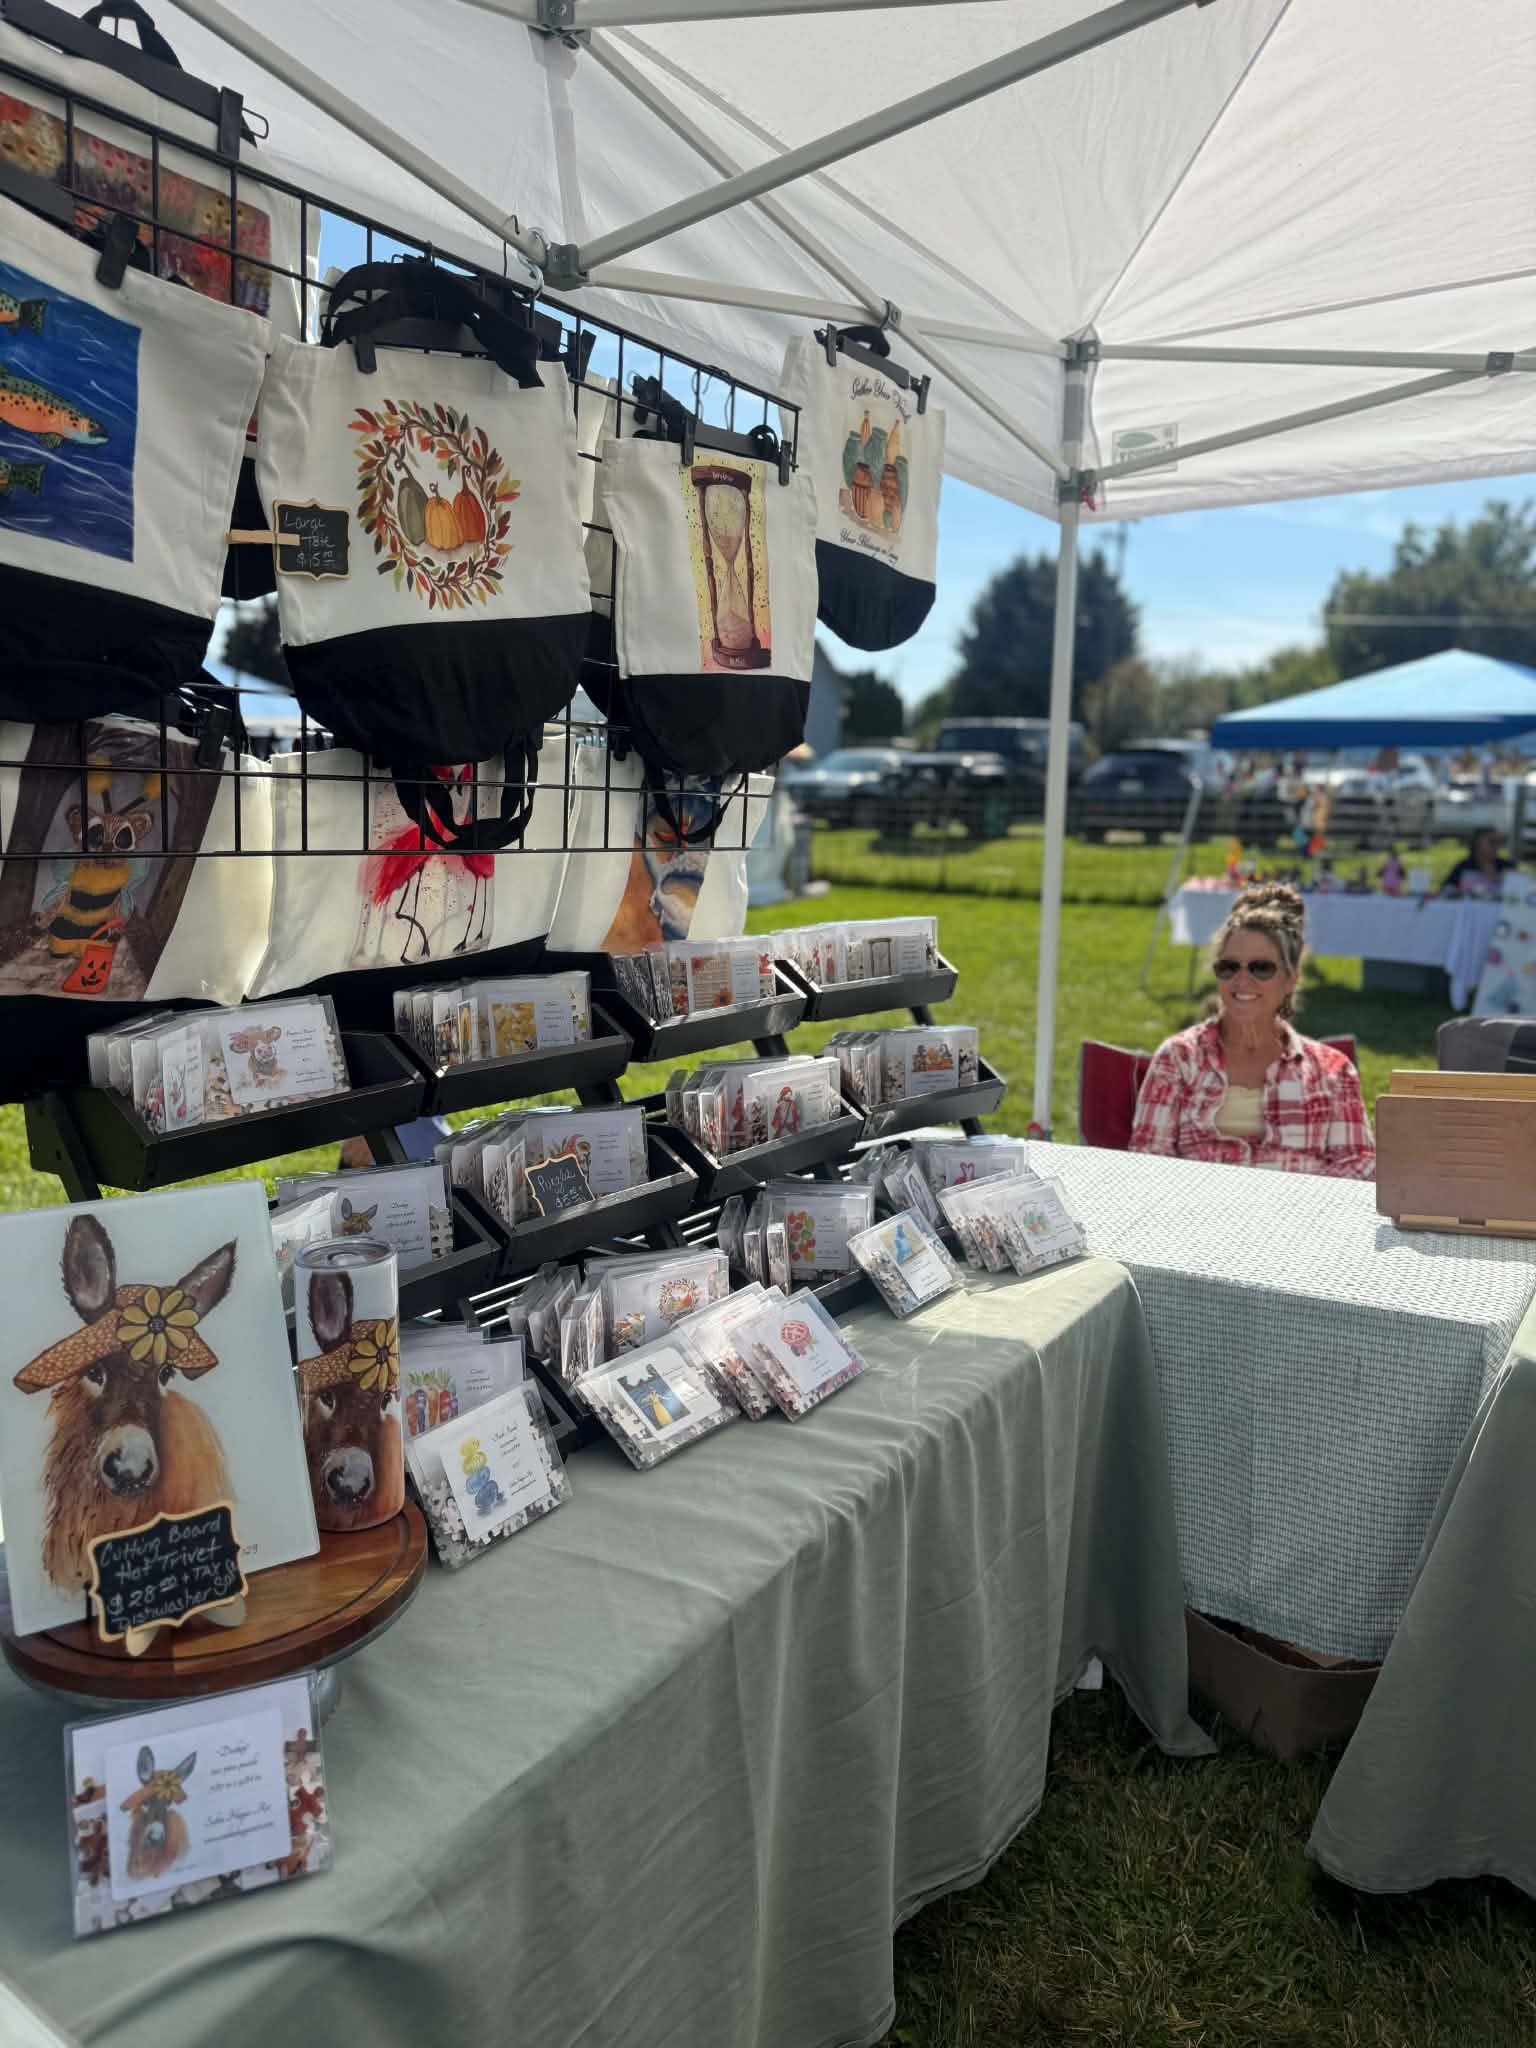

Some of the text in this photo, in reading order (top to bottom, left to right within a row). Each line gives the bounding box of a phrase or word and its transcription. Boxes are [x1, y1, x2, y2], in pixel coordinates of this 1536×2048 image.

[100, 1514, 221, 1567] Cutting Board
[114, 1537, 222, 1584] Hot Trivet
